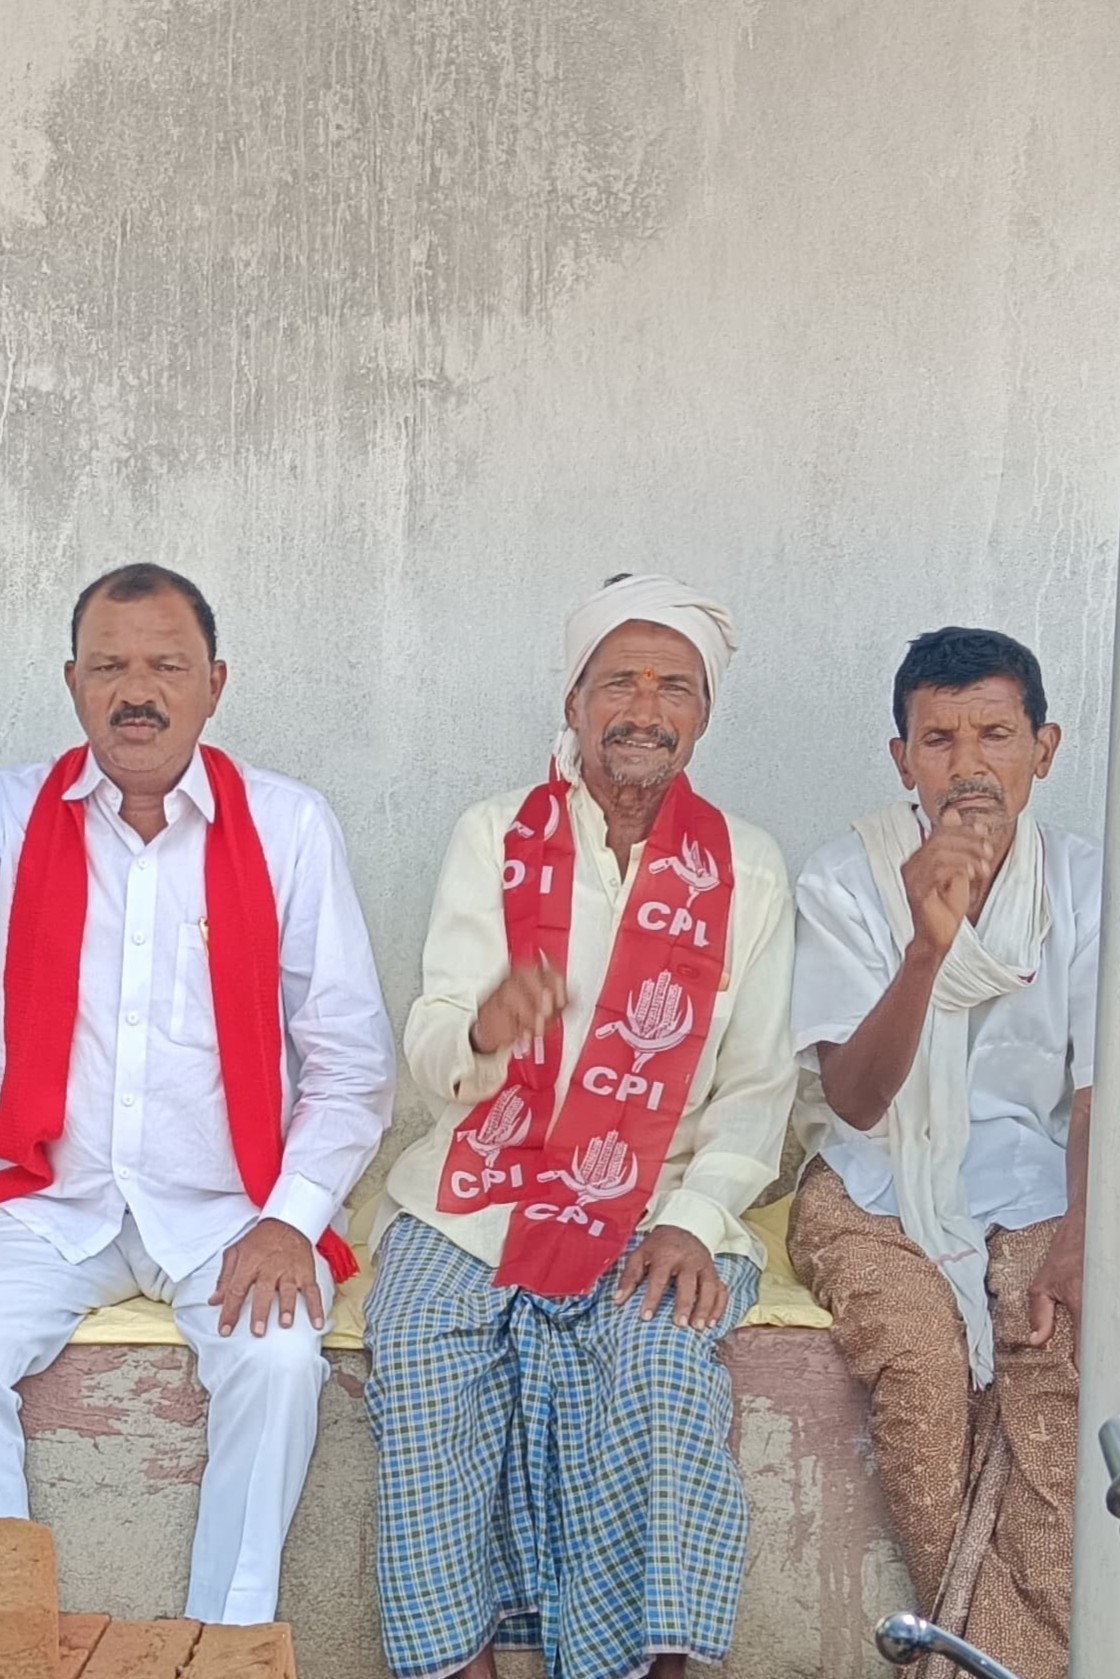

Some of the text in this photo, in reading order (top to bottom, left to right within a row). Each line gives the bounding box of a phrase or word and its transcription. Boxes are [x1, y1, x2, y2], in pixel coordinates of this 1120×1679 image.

[637, 901, 710, 948] CPI
[582, 1066, 664, 1111] CPI
[451, 1163, 523, 1199] CPI
[524, 1203, 606, 1237] CPI
